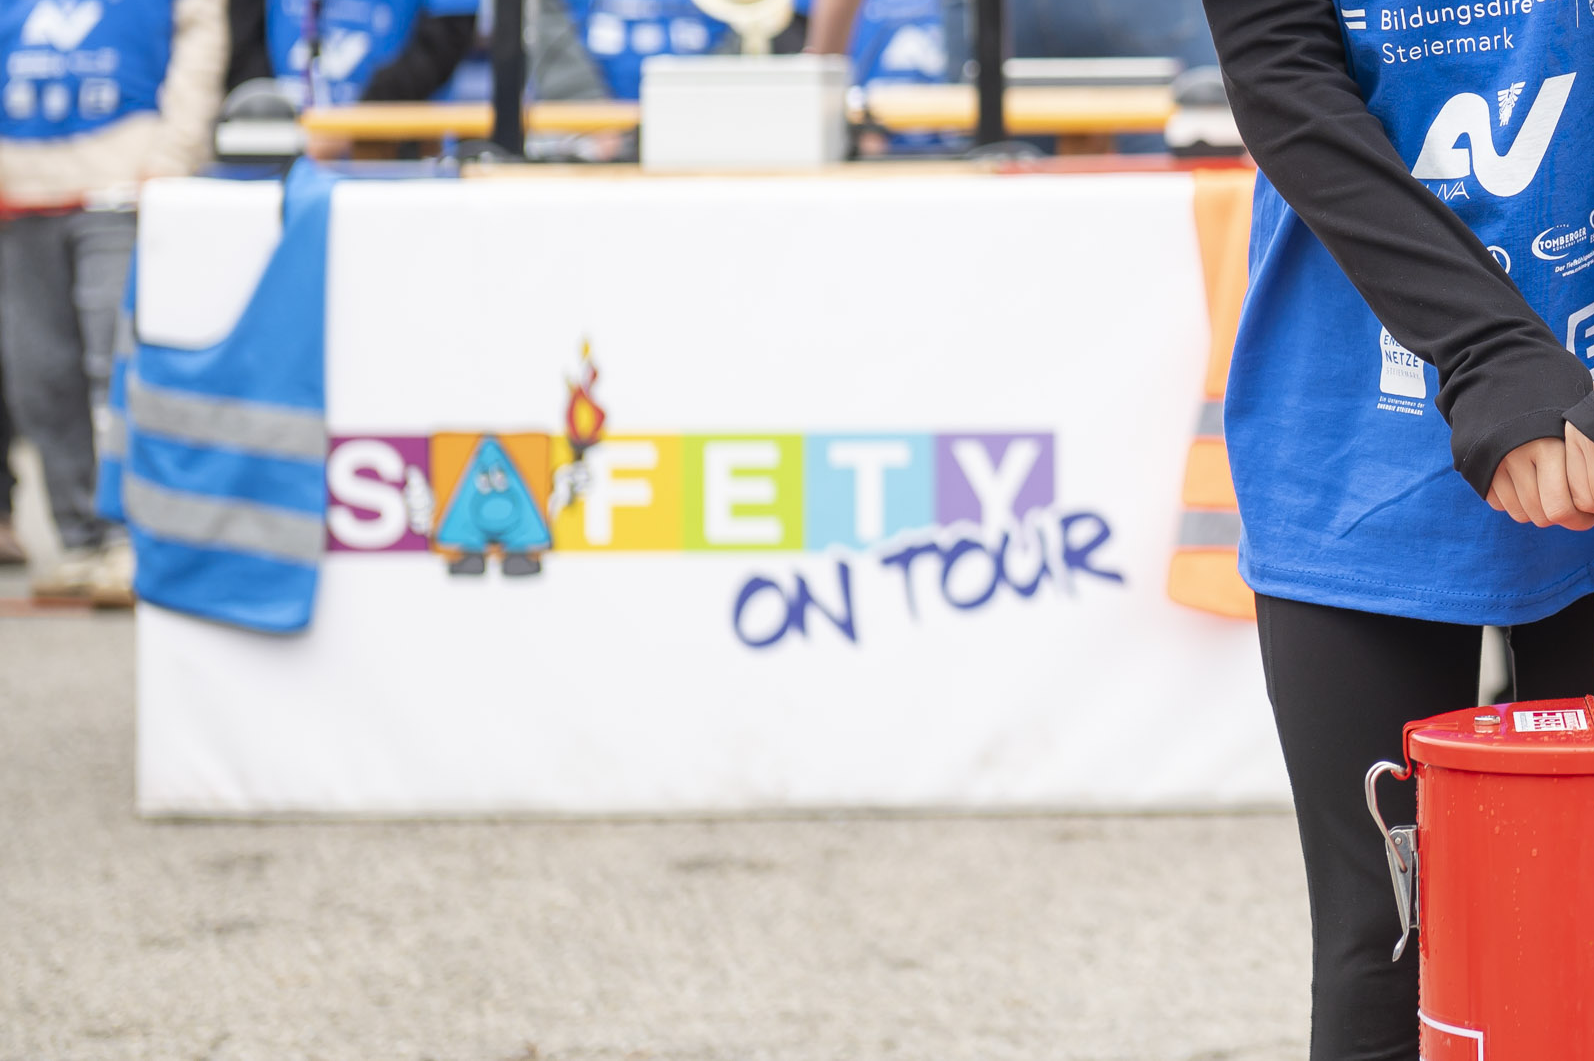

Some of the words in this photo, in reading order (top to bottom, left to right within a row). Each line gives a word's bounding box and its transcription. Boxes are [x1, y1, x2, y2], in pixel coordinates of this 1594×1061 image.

[1382, 26, 1514, 65] Steiermark
[1539, 227, 1587, 250] TOMBERGER
[1385, 349, 1419, 368] NETZE
[731, 560, 859, 649] ON
[880, 511, 1126, 623] TOUR
